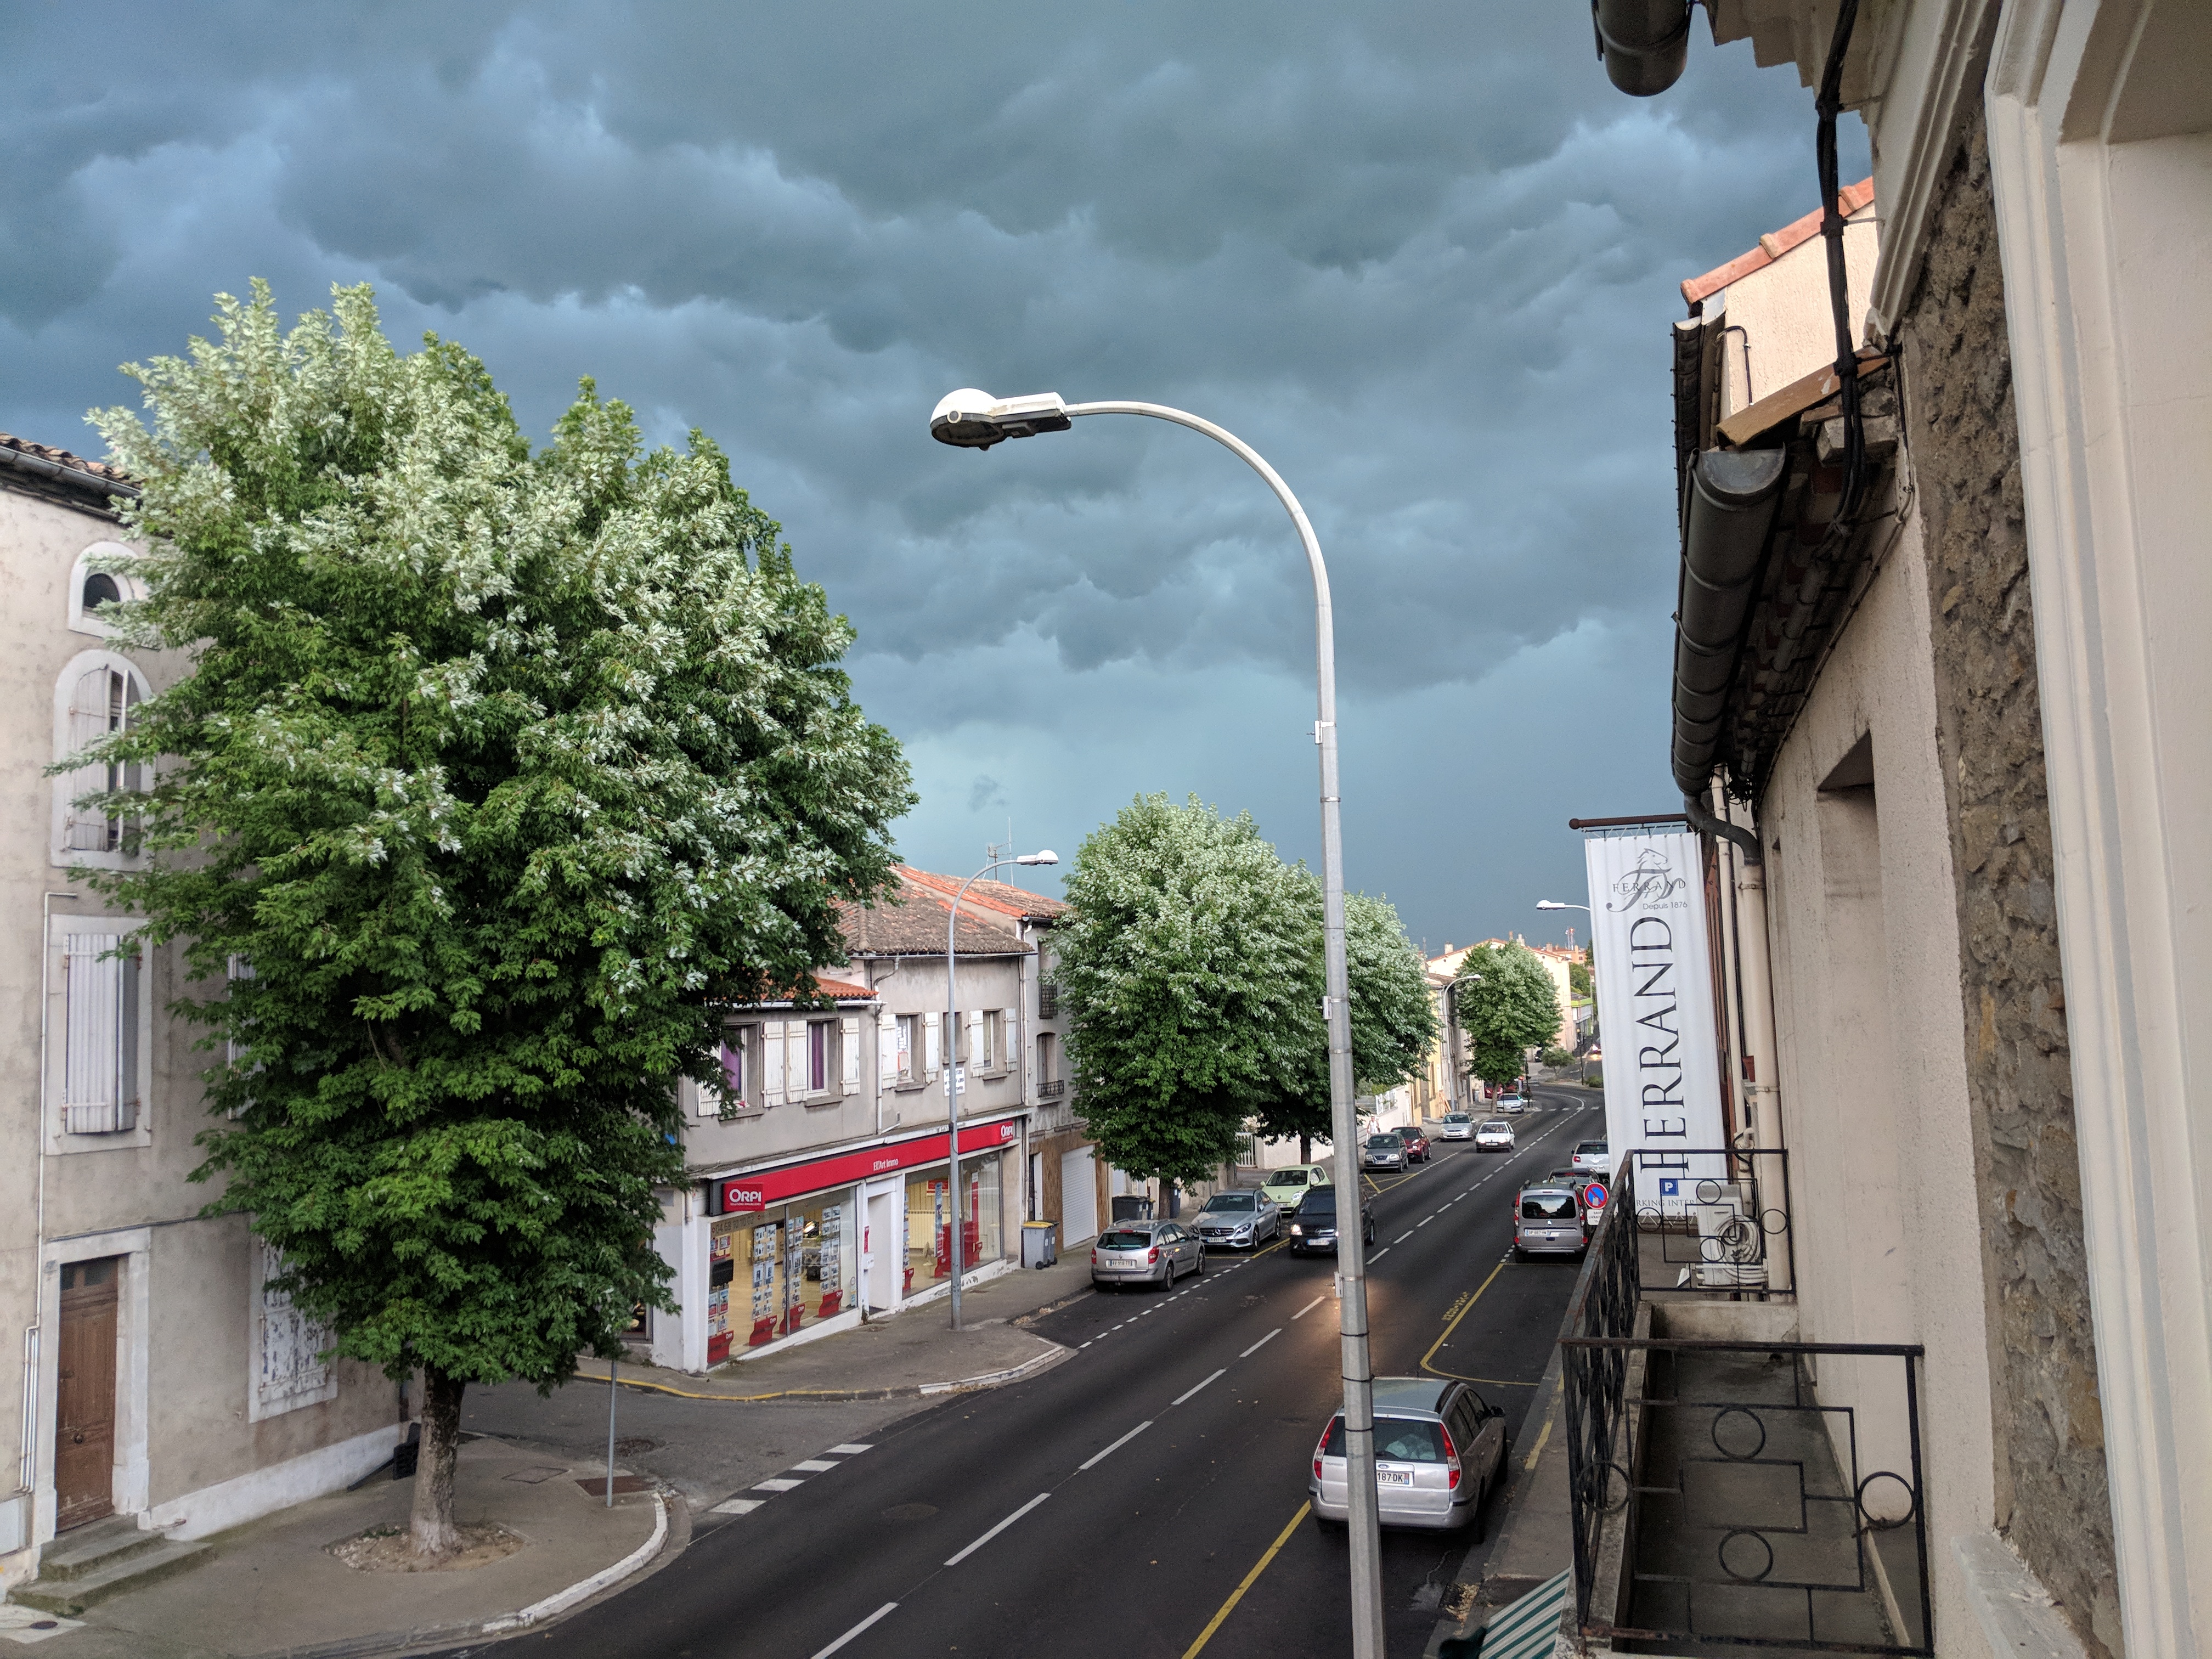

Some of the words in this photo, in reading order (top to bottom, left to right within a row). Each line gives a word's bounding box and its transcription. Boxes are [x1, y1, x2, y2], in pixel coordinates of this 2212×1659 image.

[1612, 879, 1686, 893] FERRAND
[1630, 917, 1690, 1173] FERRAND
[729, 1188, 761, 1203] ORPI
